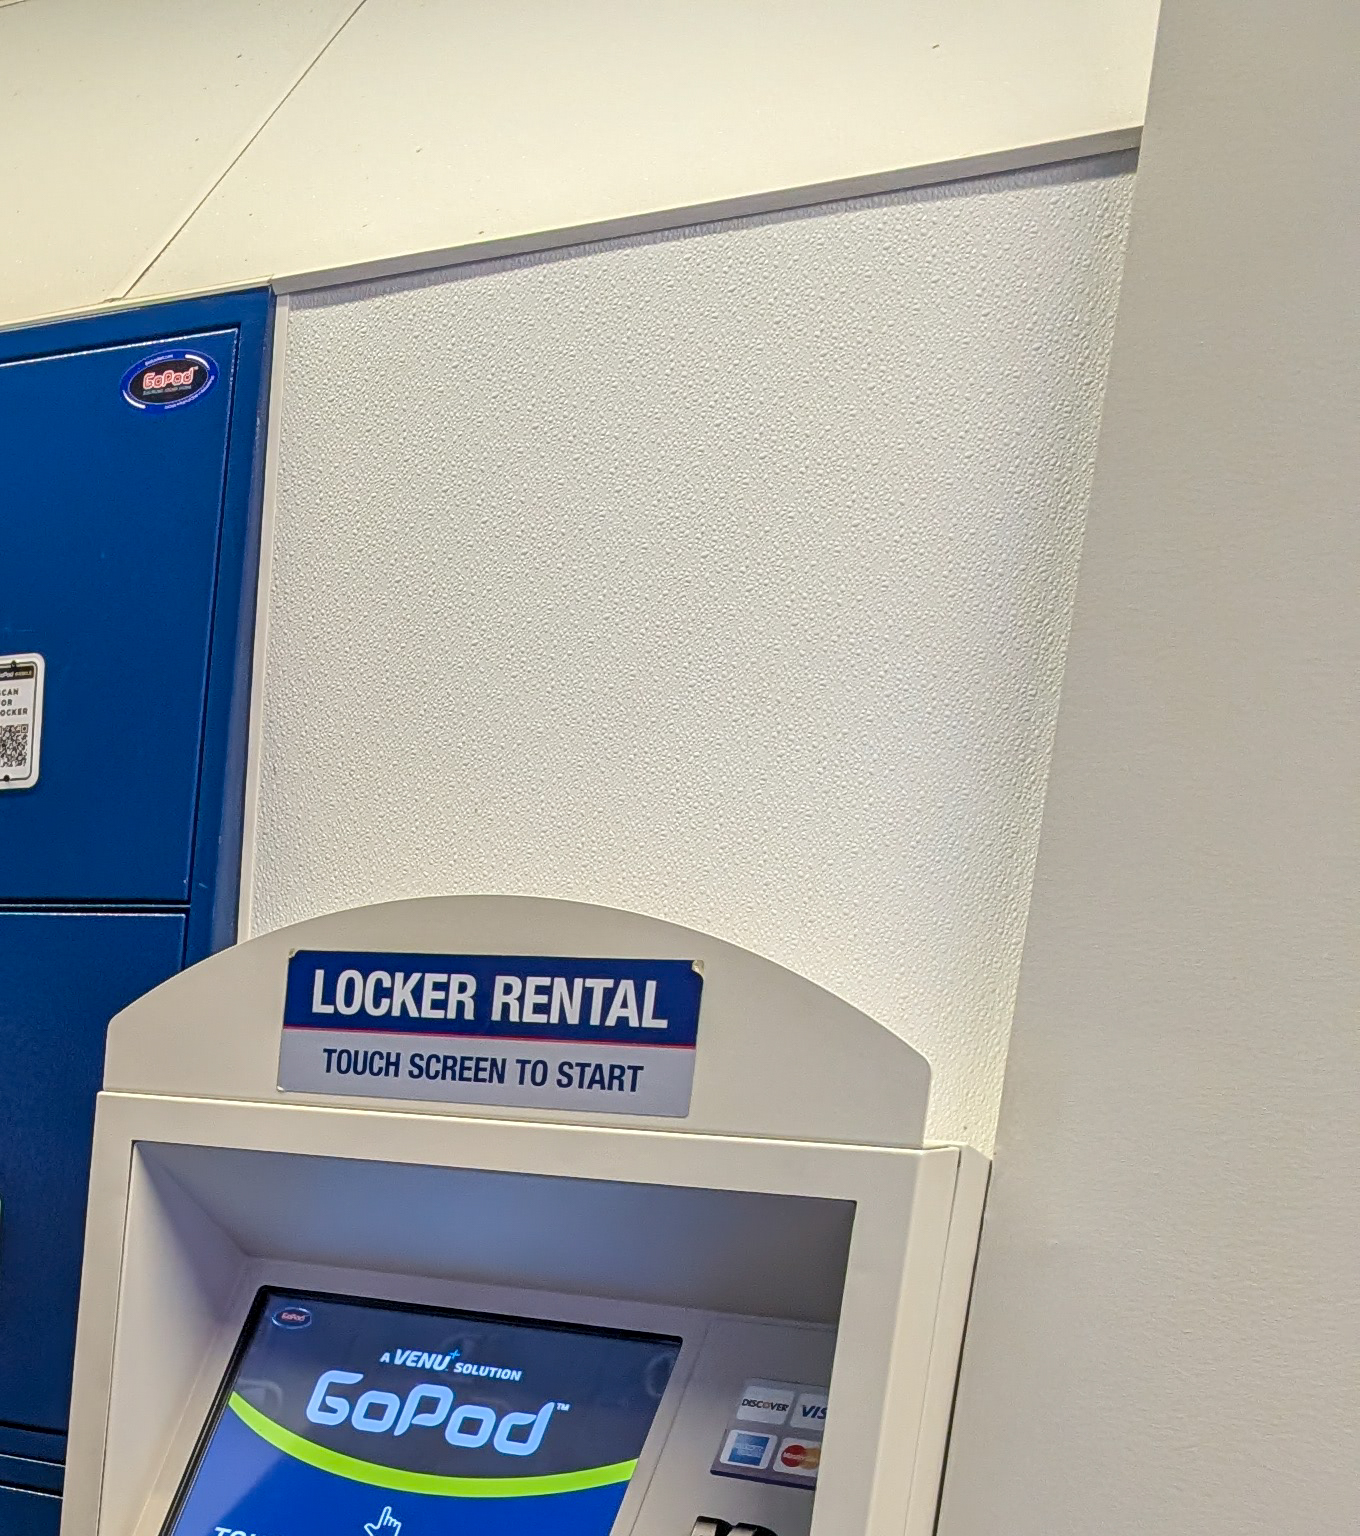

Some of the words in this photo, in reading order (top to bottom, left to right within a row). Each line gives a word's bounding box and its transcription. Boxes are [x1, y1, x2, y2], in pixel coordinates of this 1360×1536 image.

[311, 969, 477, 1021] LOCKER
[490, 975, 669, 1029] RENTAL
[322, 1048, 400, 1078] TOUCH
[408, 1053, 507, 1084] SCREEN
[514, 1059, 548, 1087] TO
[556, 1062, 644, 1093] START
[380, 1351, 391, 1364] A
[454, 1361, 522, 1382] SOLUTION
[742, 1398, 789, 1412] DISCOVER
[802, 1405, 827, 1419] VIS
